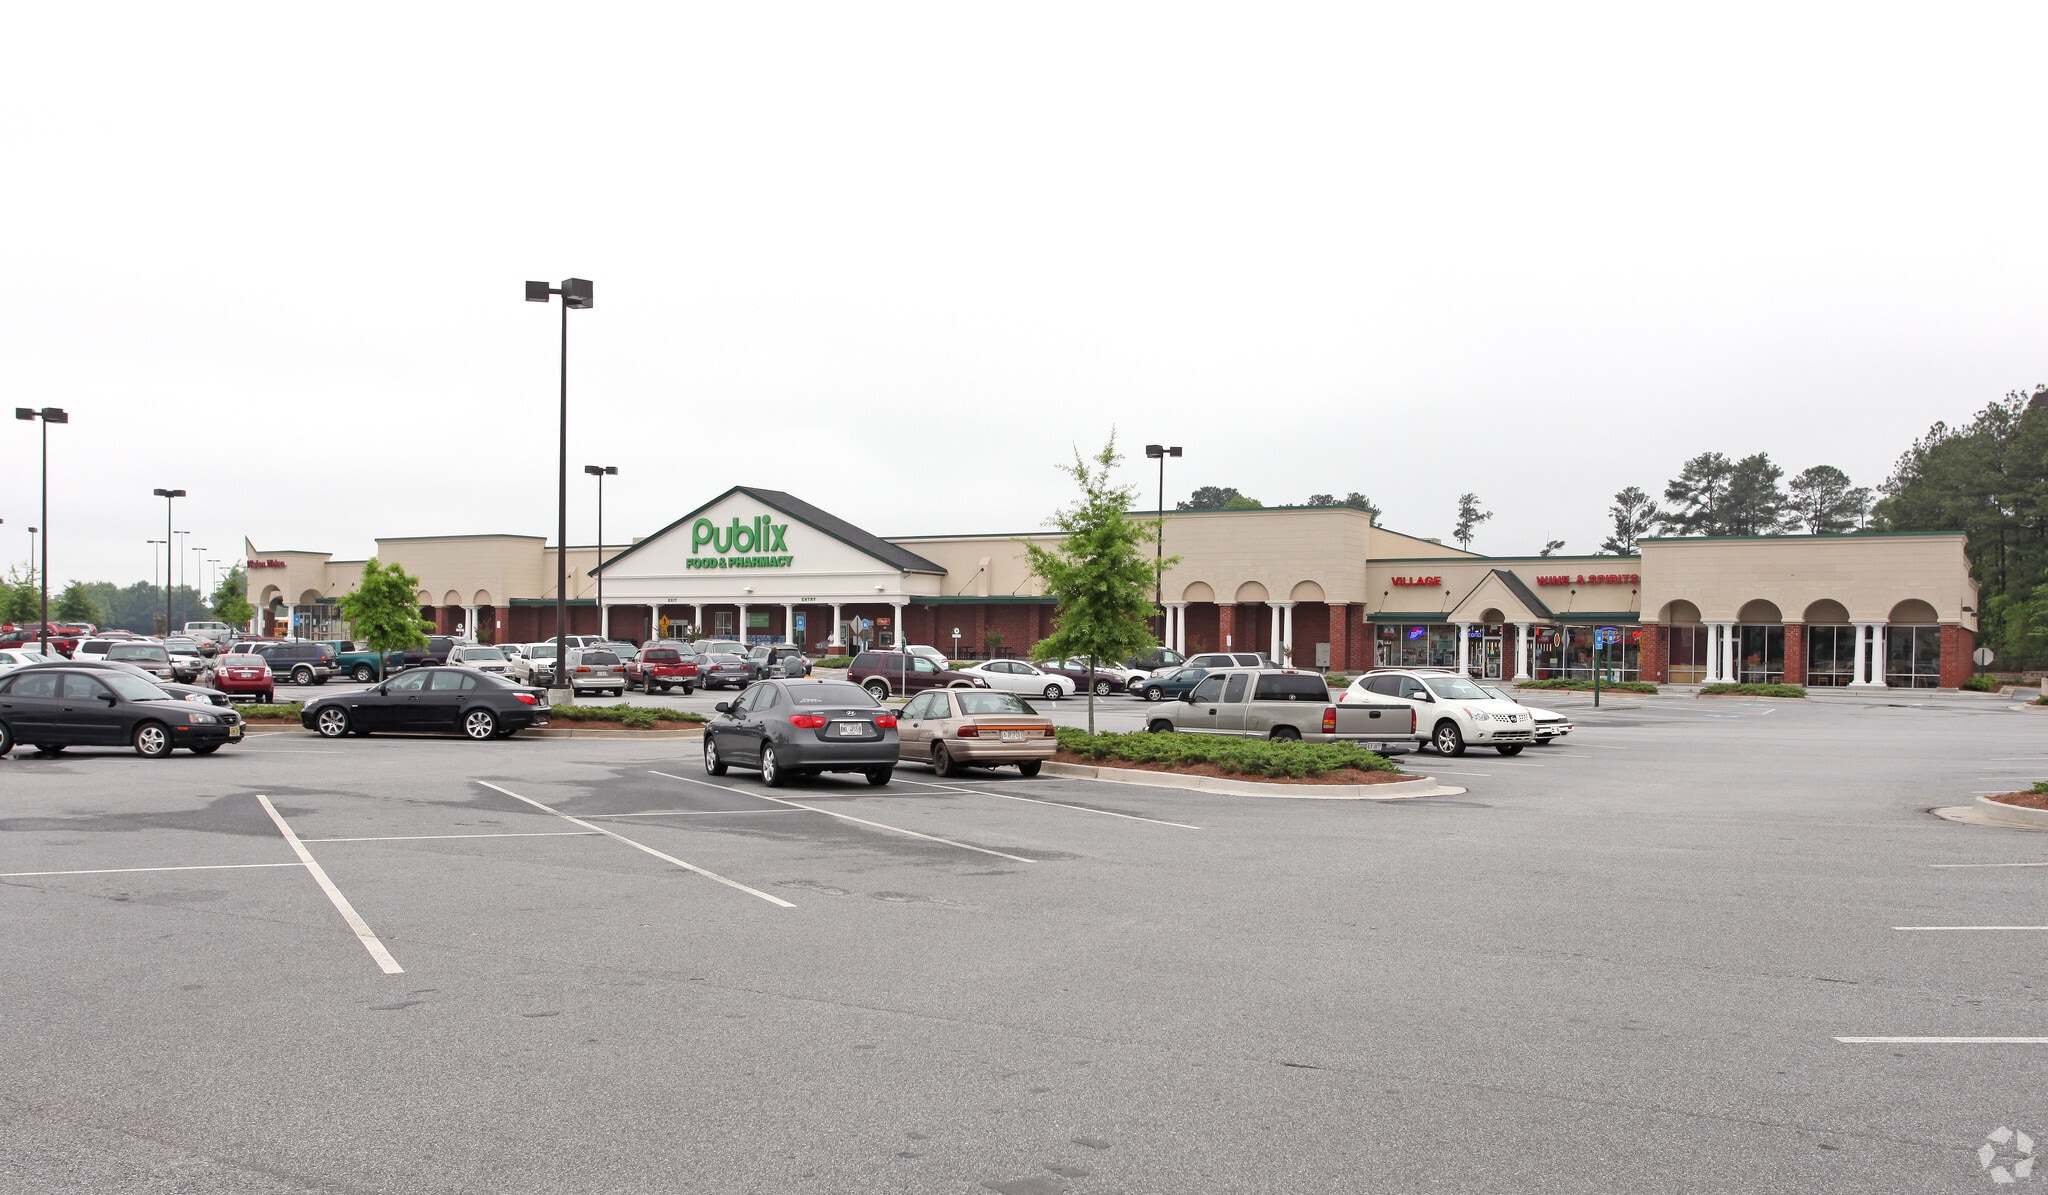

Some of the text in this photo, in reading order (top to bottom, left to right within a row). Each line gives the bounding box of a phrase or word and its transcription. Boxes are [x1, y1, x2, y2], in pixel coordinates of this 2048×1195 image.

[692, 514, 788, 554] Publix
[686, 556, 794, 569] FOOD & PHARMACY
[1391, 576, 1442, 587] VILLAGE
[1536, 573, 1640, 585] WINE & SPIRITS
